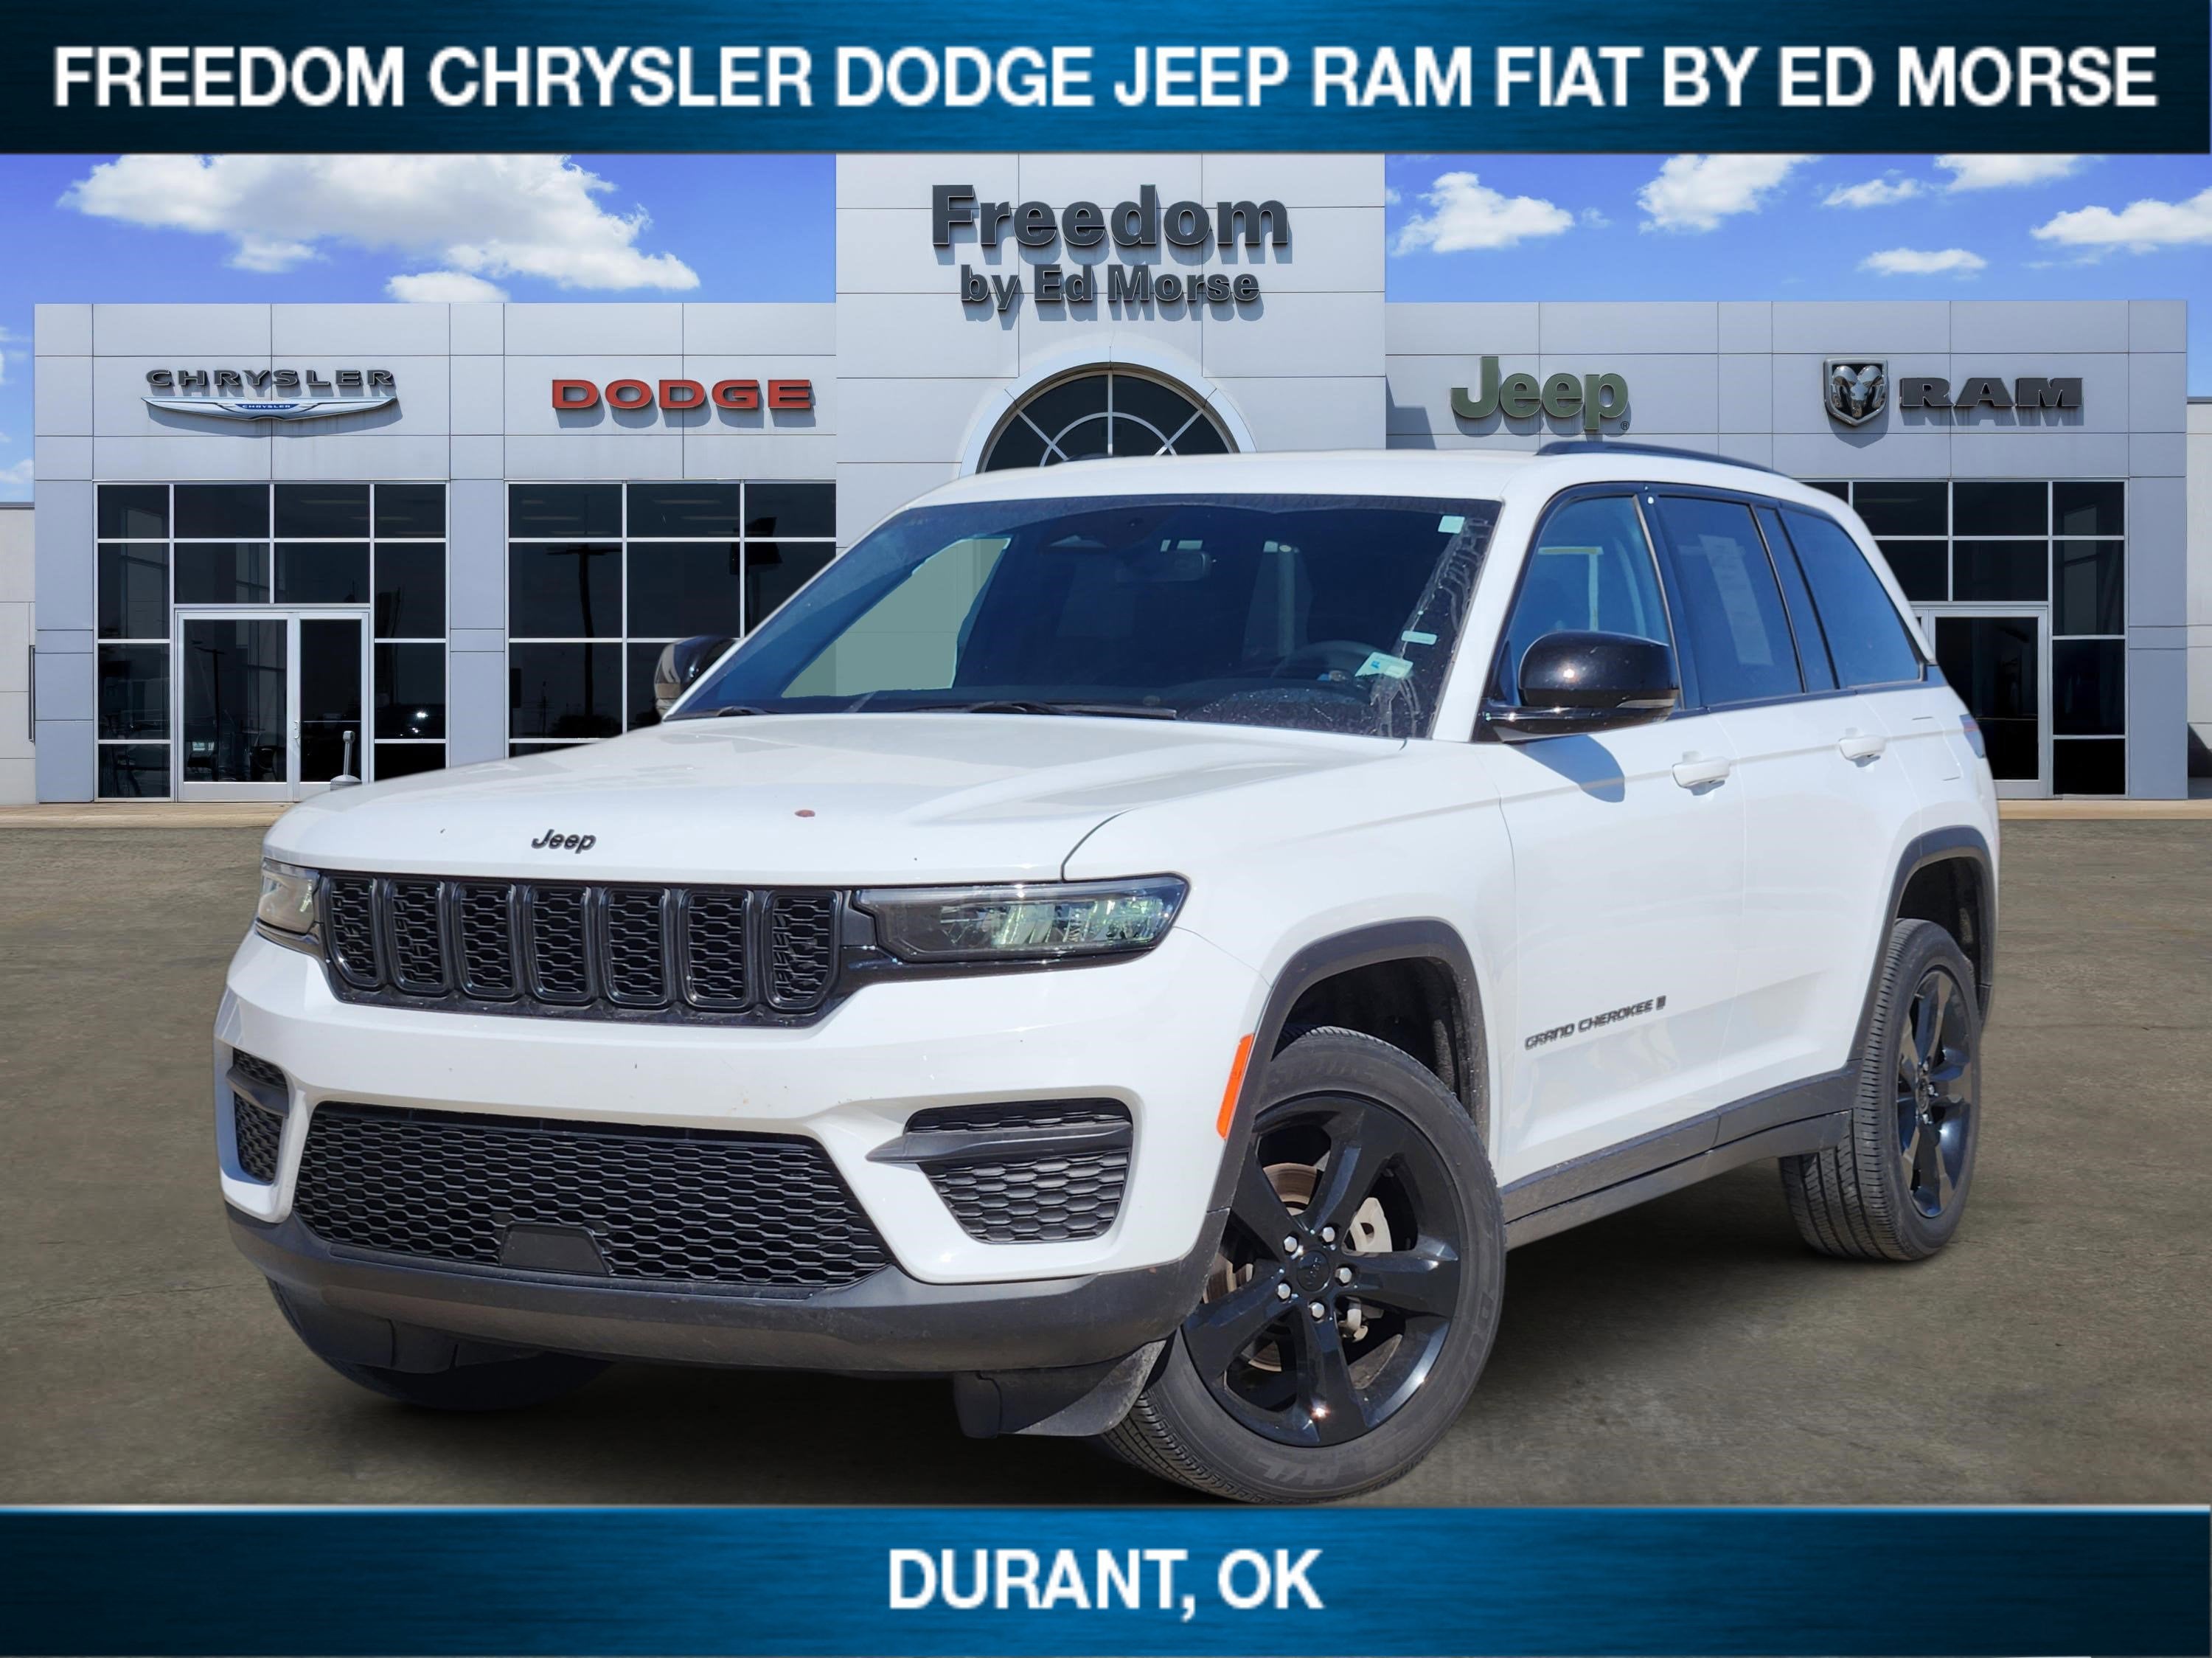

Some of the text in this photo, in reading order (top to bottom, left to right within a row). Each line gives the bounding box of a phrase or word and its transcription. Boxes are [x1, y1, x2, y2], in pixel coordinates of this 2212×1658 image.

[932, 184, 1289, 246] Freedom
[961, 264, 1260, 311] by Ed Morse
[146, 370, 394, 386] CHRYSLER
[552, 379, 811, 409] DODGE
[1450, 356, 1629, 431] Jeep
[1899, 377, 2083, 407] RAM
[531, 828, 597, 854] Jeep
[1525, 999, 1654, 1050] GRAND CHEROKEE
